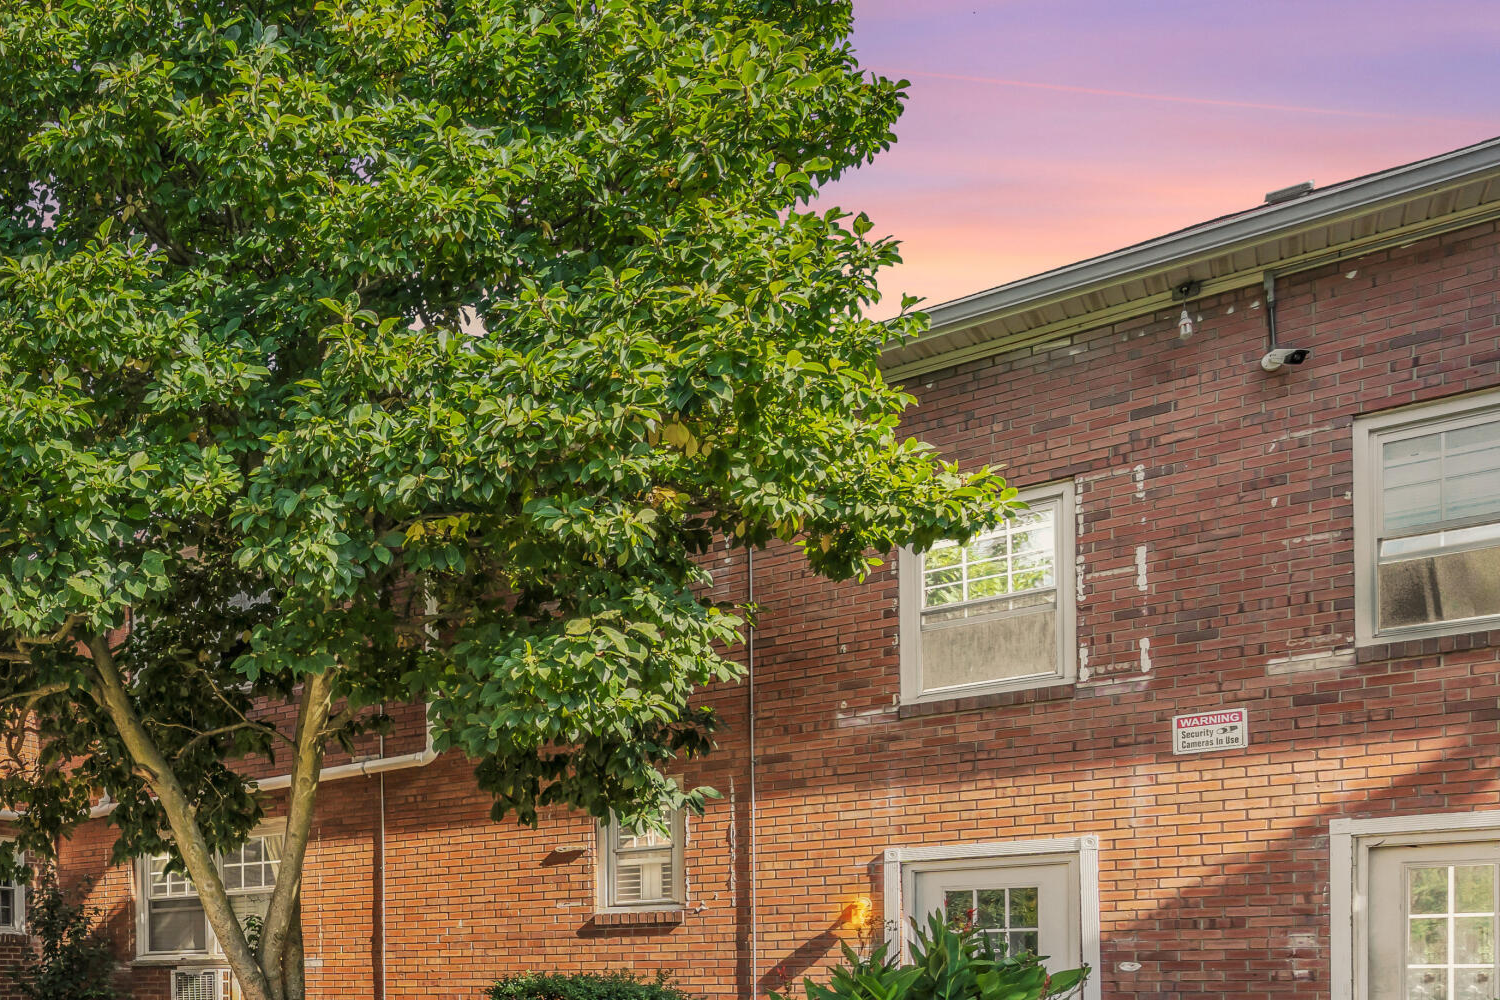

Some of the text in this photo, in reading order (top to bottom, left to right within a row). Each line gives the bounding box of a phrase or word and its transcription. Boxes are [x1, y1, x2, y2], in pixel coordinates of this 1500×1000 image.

[1180, 713, 1240, 727] WARNING
[1181, 729, 1214, 739] Security
[1181, 739, 1214, 749] Cameras
[1225, 736, 1239, 744] Use
